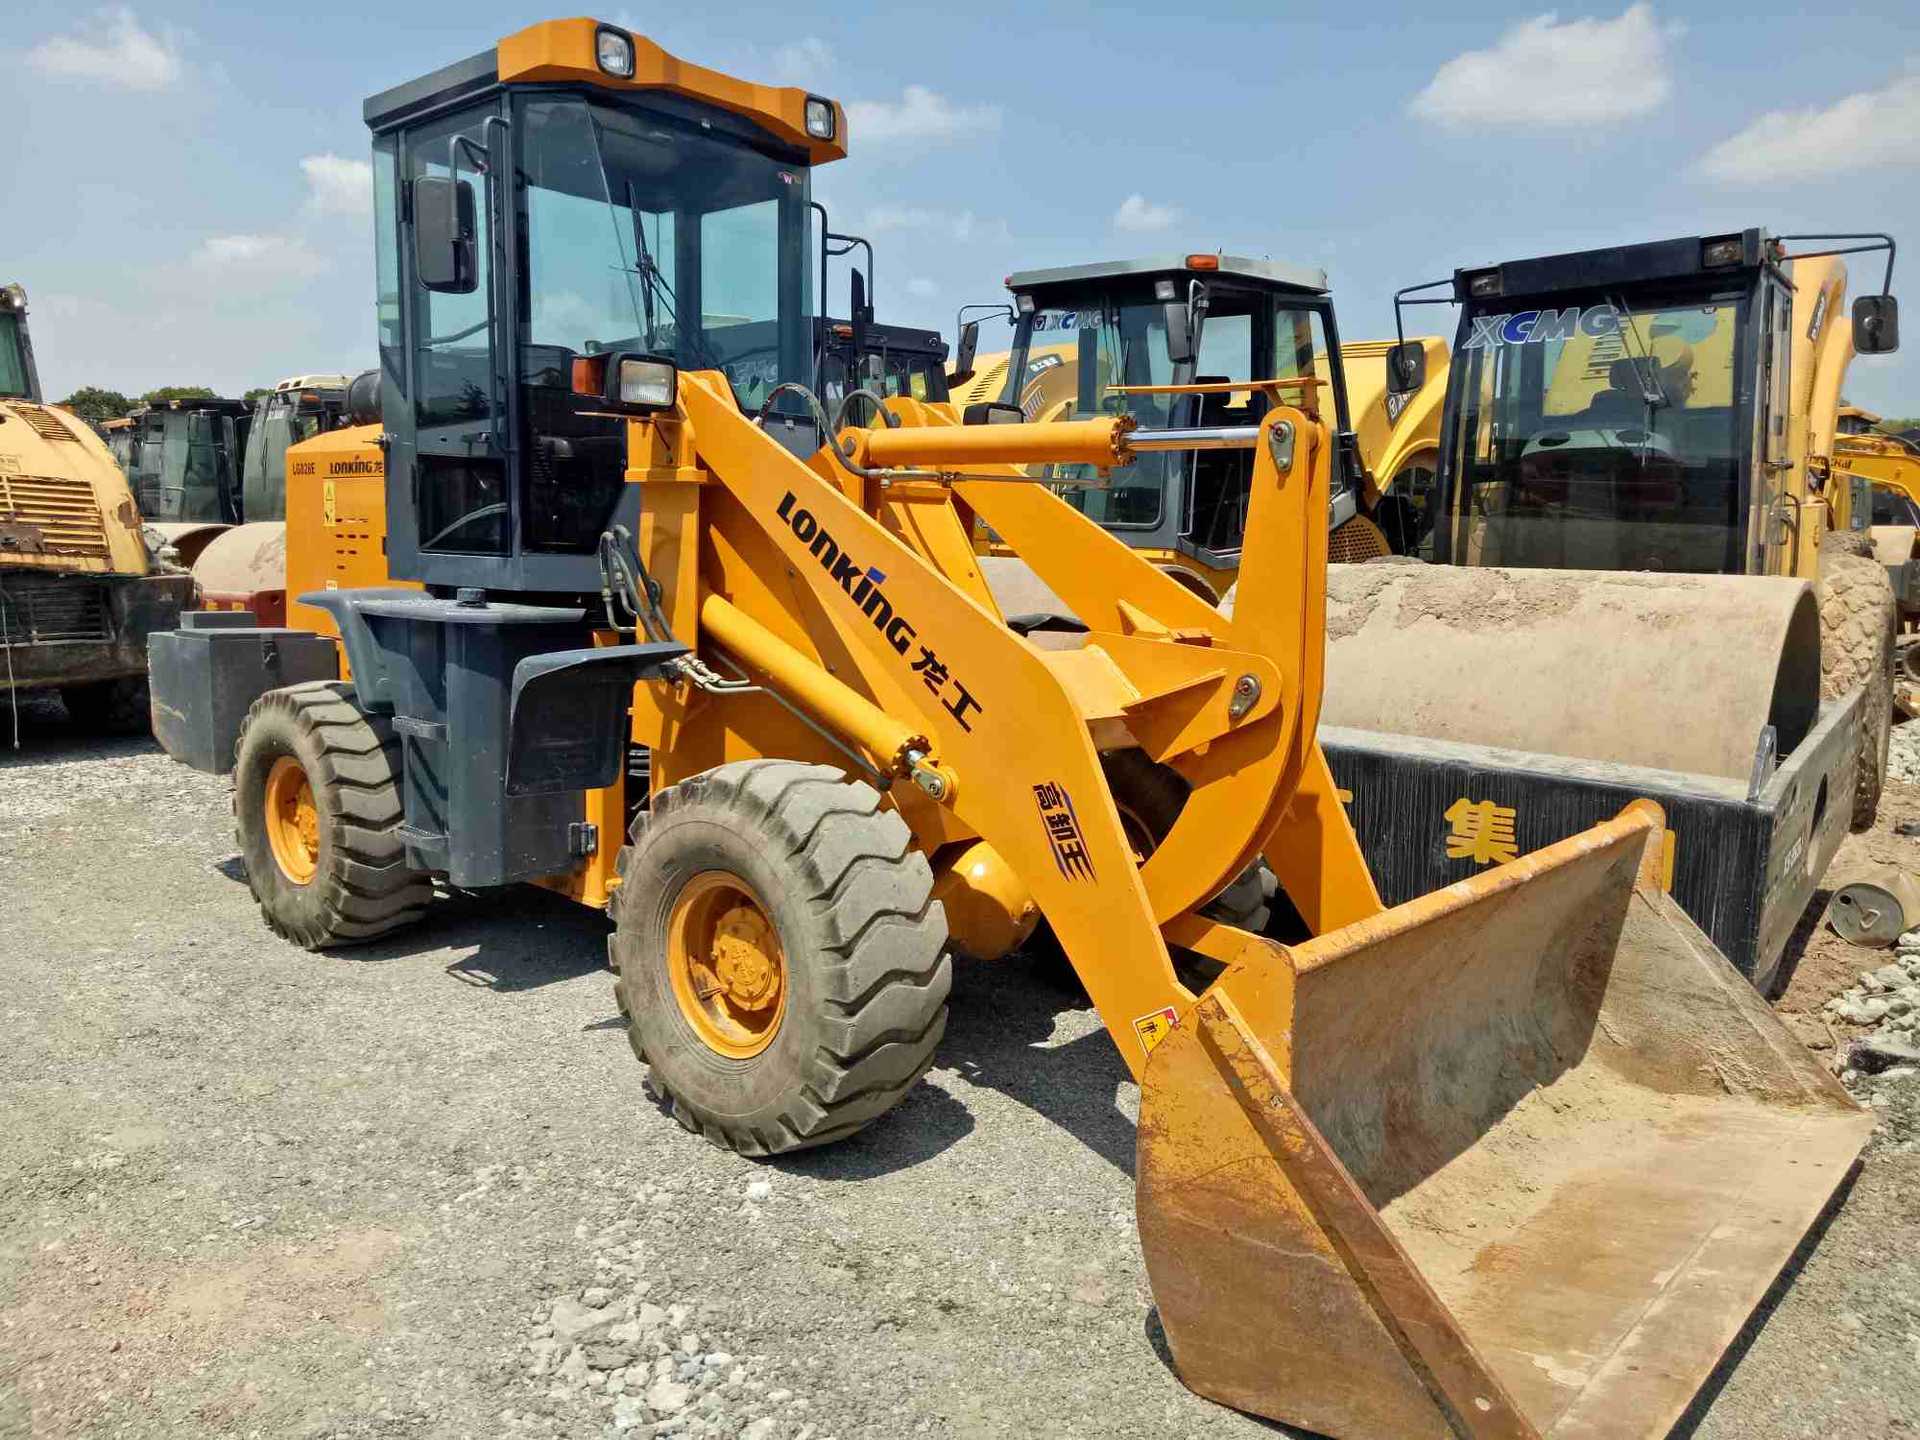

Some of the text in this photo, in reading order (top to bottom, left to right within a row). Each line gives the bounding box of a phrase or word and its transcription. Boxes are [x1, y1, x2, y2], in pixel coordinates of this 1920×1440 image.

[1461, 304, 1620, 350] XCMG
[776, 490, 983, 734] LONKING 龙工
